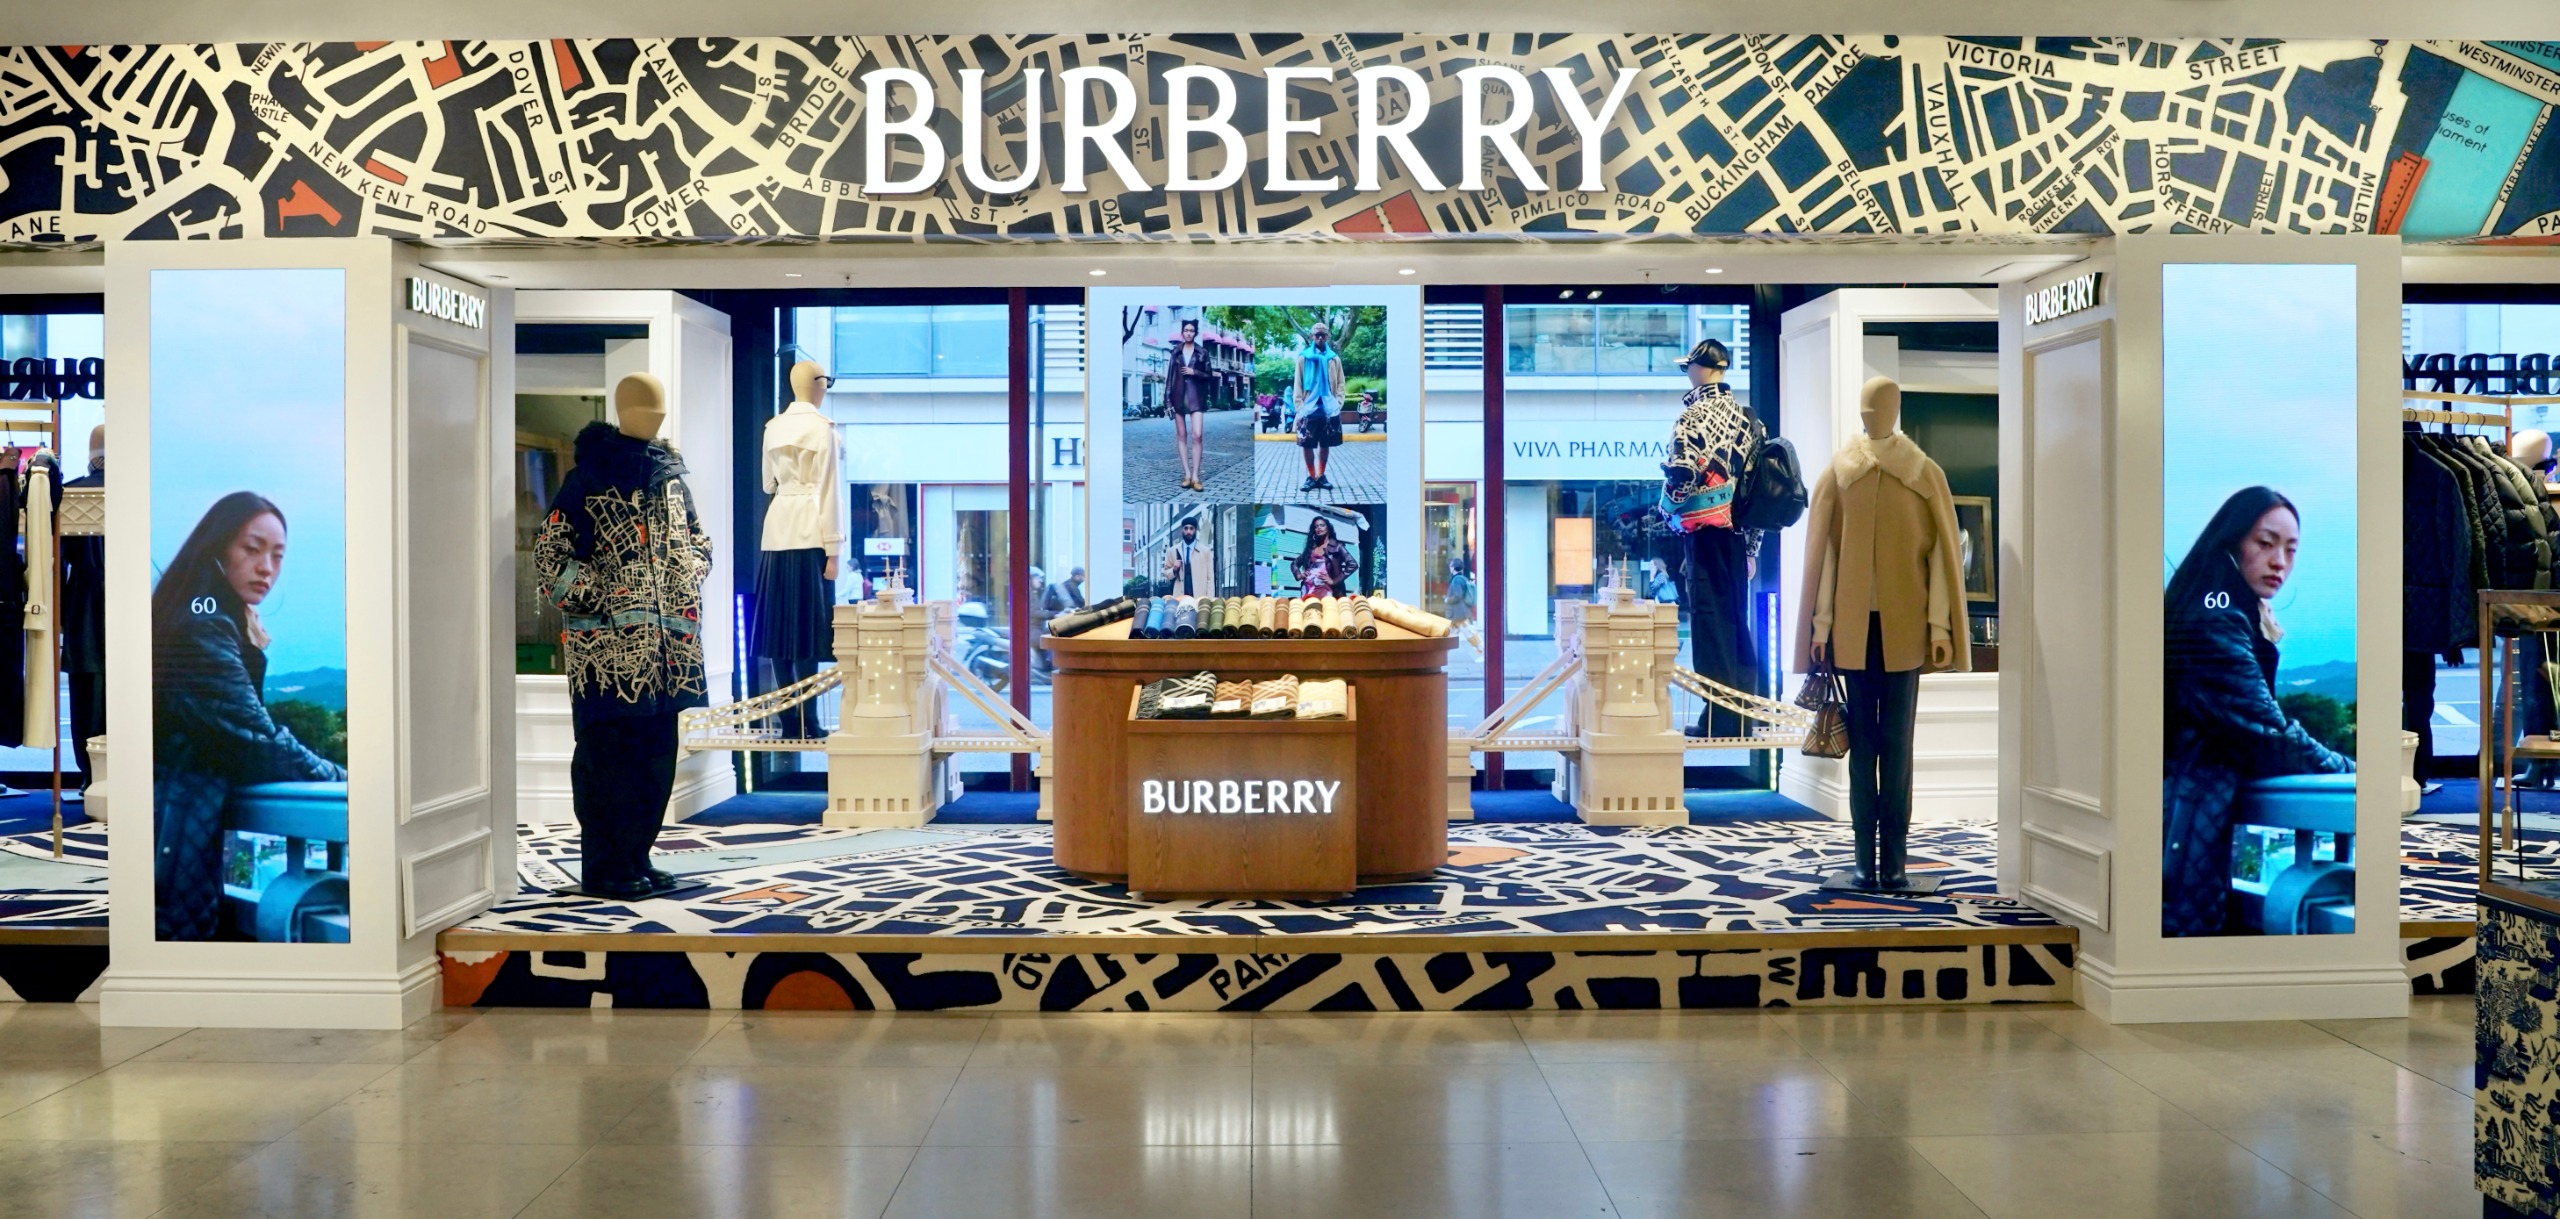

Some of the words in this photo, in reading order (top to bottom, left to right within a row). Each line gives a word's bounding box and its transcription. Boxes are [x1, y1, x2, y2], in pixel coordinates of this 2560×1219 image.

[644, 43, 688, 98] LANE
[1660, 38, 1710, 108] ELIZABETH
[1744, 34, 1774, 75] STON
[1947, 41, 2055, 78] VICTORIA
[2188, 45, 2280, 80] STREET
[2459, 42, 2560, 96] WESTMINSTER
[508, 50, 543, 129] DOVER
[548, 171, 571, 204] ST.
[778, 62, 849, 148] BRIDGE
[860, 65, 1641, 195] BURBERRY
[2474, 125, 2491, 136] of
[1685, 114, 1795, 222] BUCKINGHAM
[1804, 43, 1864, 105] PALACE
[1926, 83, 1972, 213] VAUXHALL
[2499, 112, 2551, 203] EMBANKMENT
[308, 141, 352, 178] NEW
[358, 177, 416, 209] KENT
[427, 196, 487, 235] ROAD
[802, 177, 881, 202] ABBE
[2018, 167, 2081, 223] ROCHESTER
[2096, 132, 2121, 156] ROW
[2252, 171, 2275, 221] STREET
[2350, 172, 2377, 233] MILLBA
[628, 179, 710, 235] TOWER
[1511, 191, 1590, 224] PIMLICO
[1614, 193, 1667, 215] ROAD
[2032, 194, 2079, 235] VINCENT
[411, 277, 487, 330] BURBERRY
[2025, 273, 2098, 326] BURBERRY
[1051, 437, 1085, 466] H
[1513, 441, 1561, 458] VIVA
[191, 596, 217, 615] 60
[2204, 591, 2230, 609] 60
[1142, 779, 1341, 814] BURBERRY
